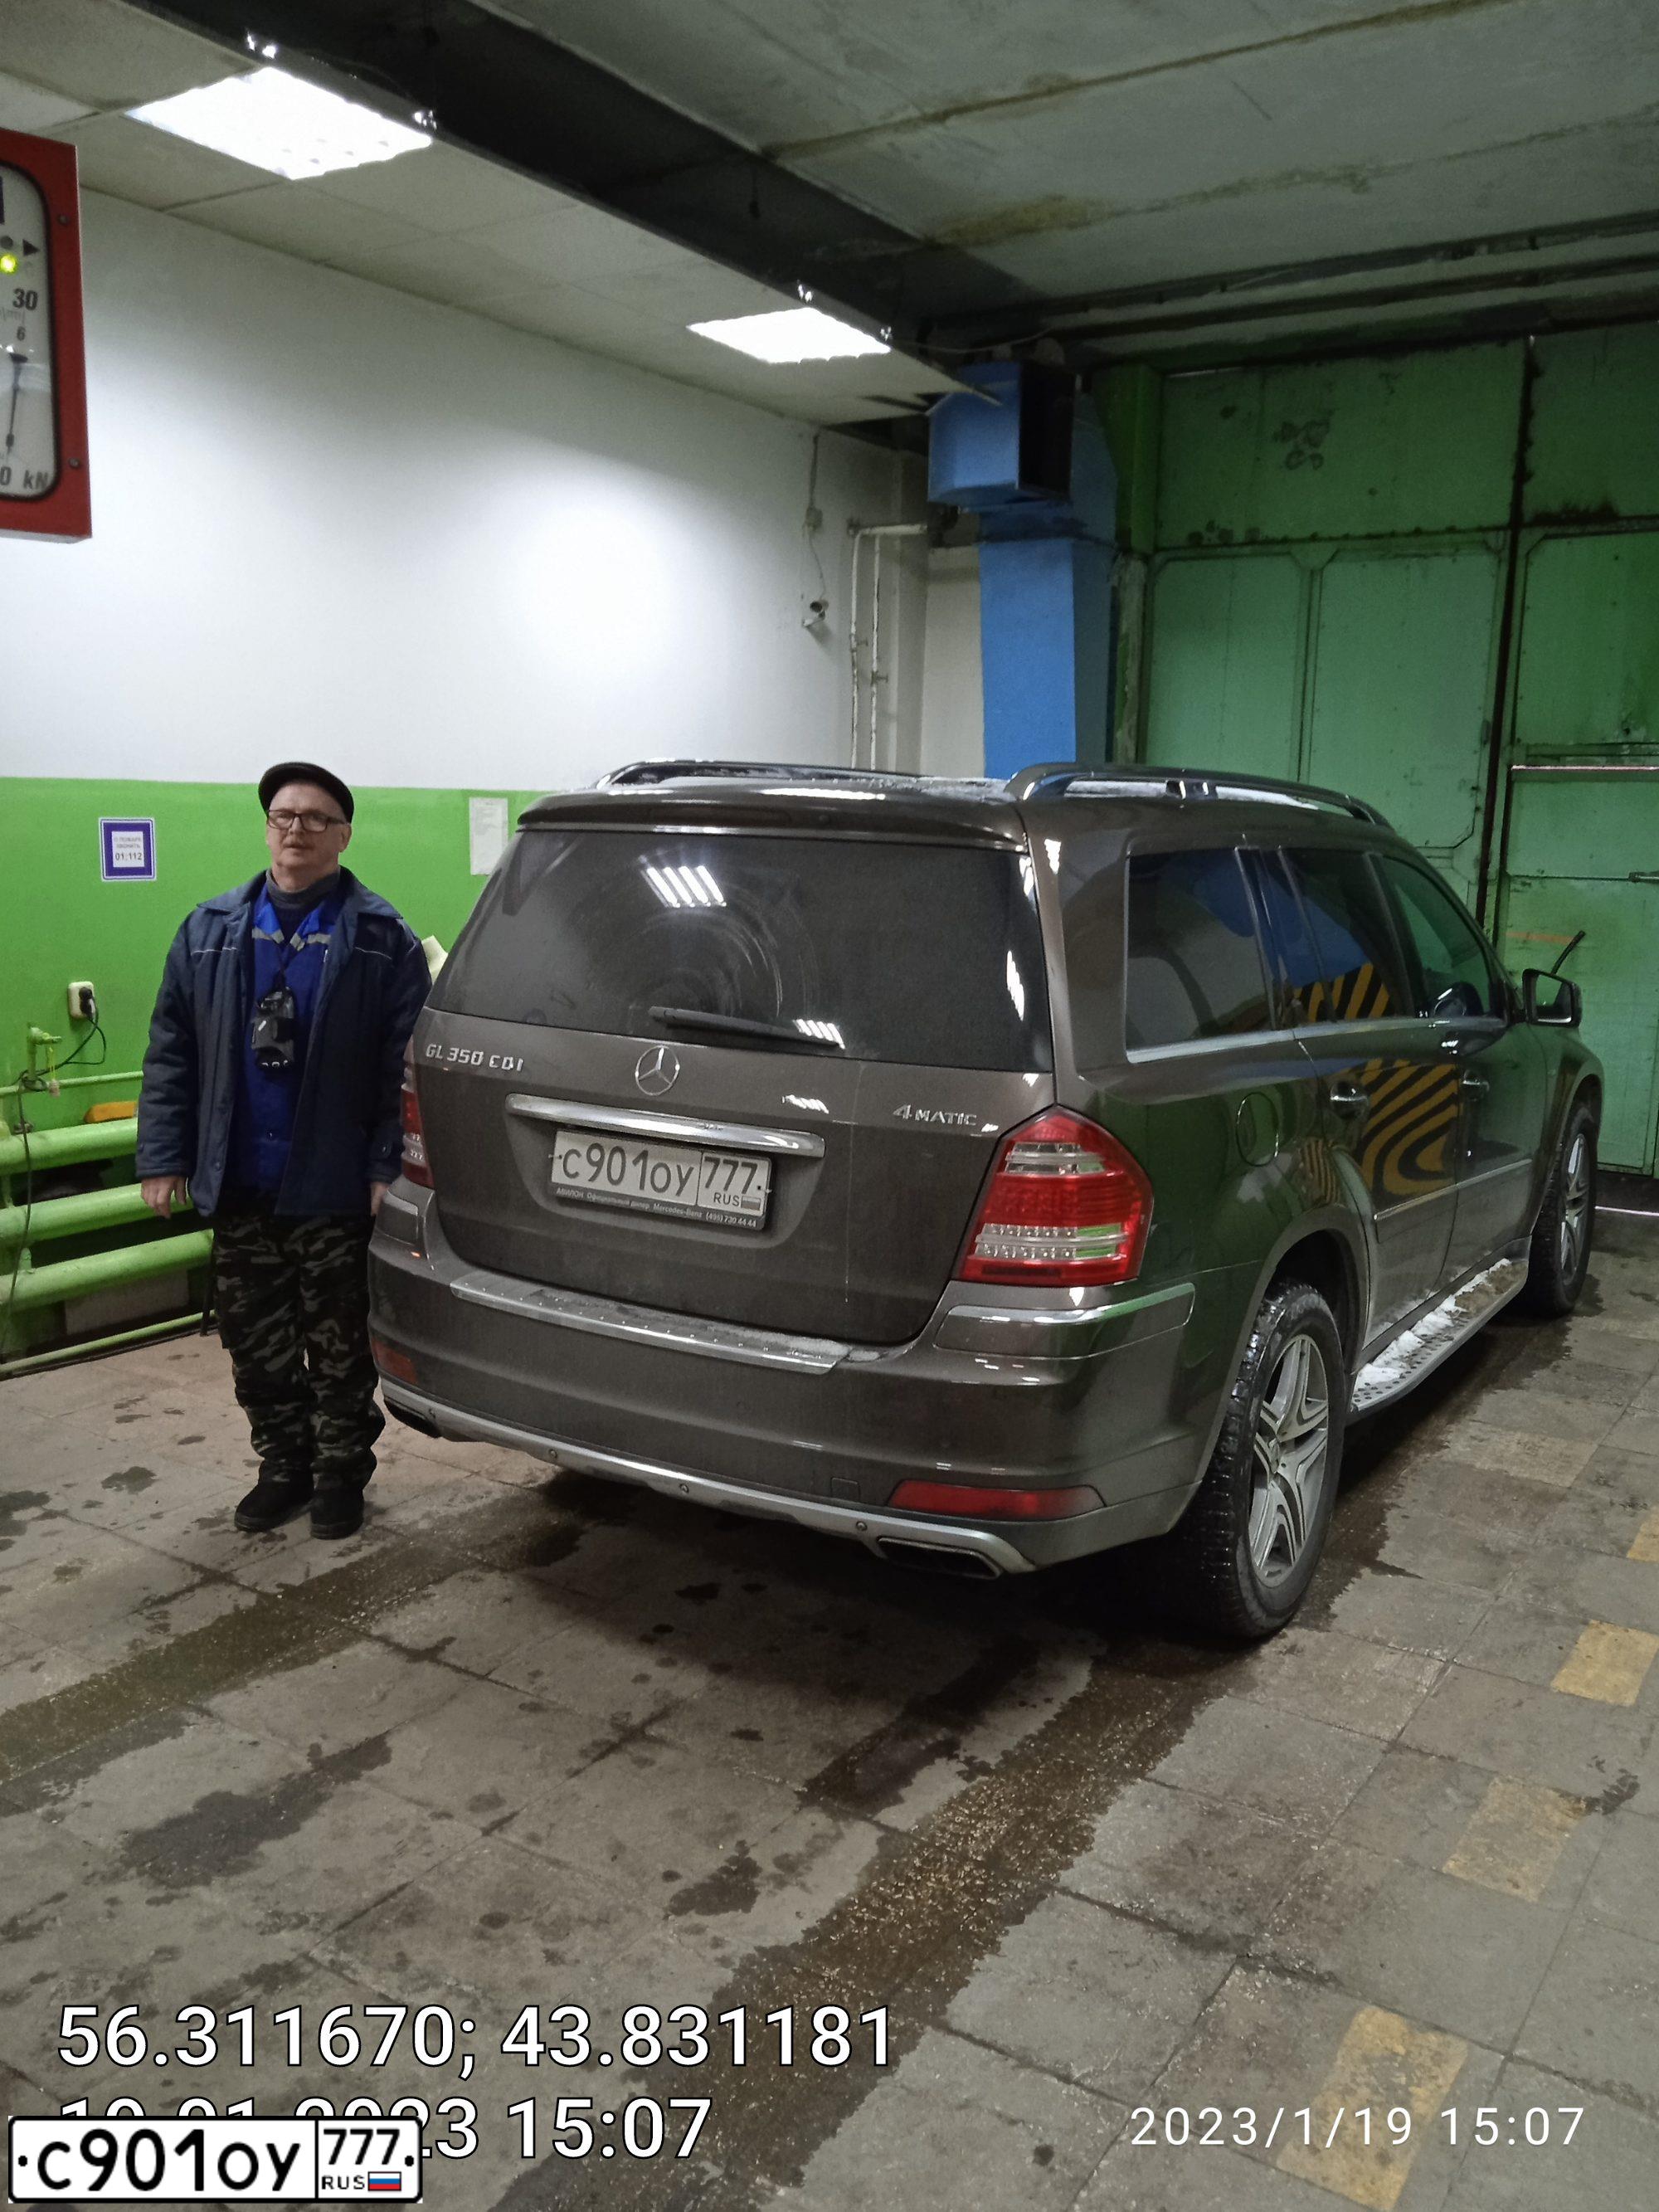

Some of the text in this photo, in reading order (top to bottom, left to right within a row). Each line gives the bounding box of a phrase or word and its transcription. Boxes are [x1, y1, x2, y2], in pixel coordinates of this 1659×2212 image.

[13, 287, 38, 311] 30
[17, 326, 26, 341] 6
[426, 1044, 523, 1071] GL 350 CDI
[704, 1157, 757, 1195] 777
[713, 1191, 740, 1207] RUS
